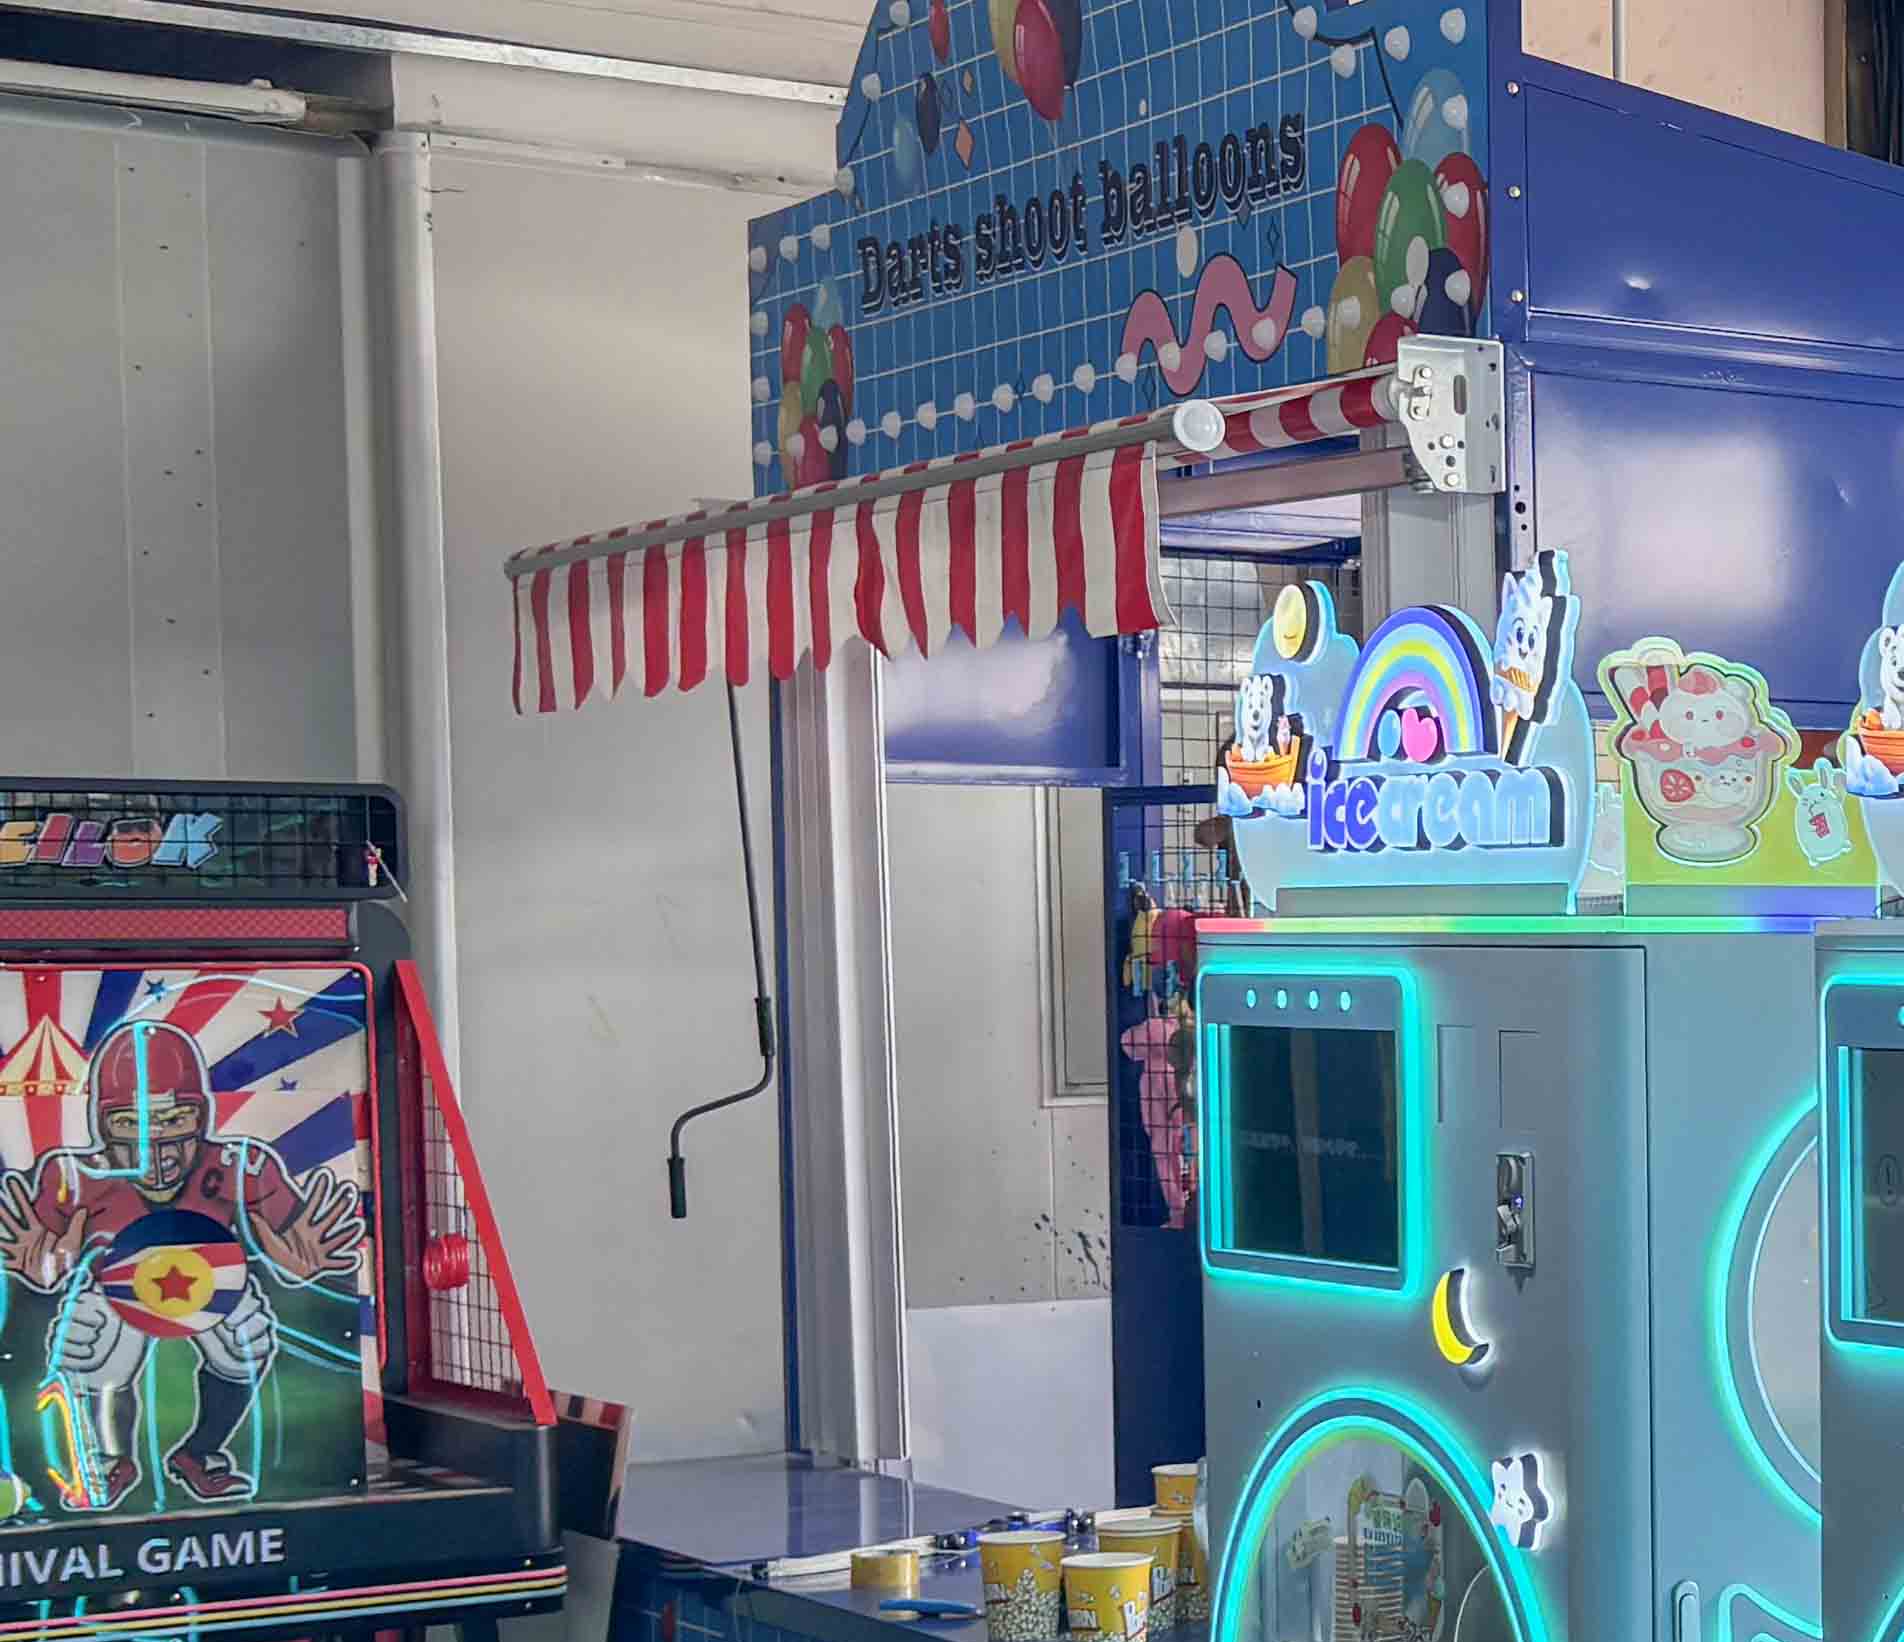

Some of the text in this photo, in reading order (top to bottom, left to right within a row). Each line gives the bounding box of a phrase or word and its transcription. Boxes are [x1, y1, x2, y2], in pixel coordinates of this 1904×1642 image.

[857, 111, 1307, 314] Darts shoot balloons
[0, 1528, 287, 1587] IVAL GAME
